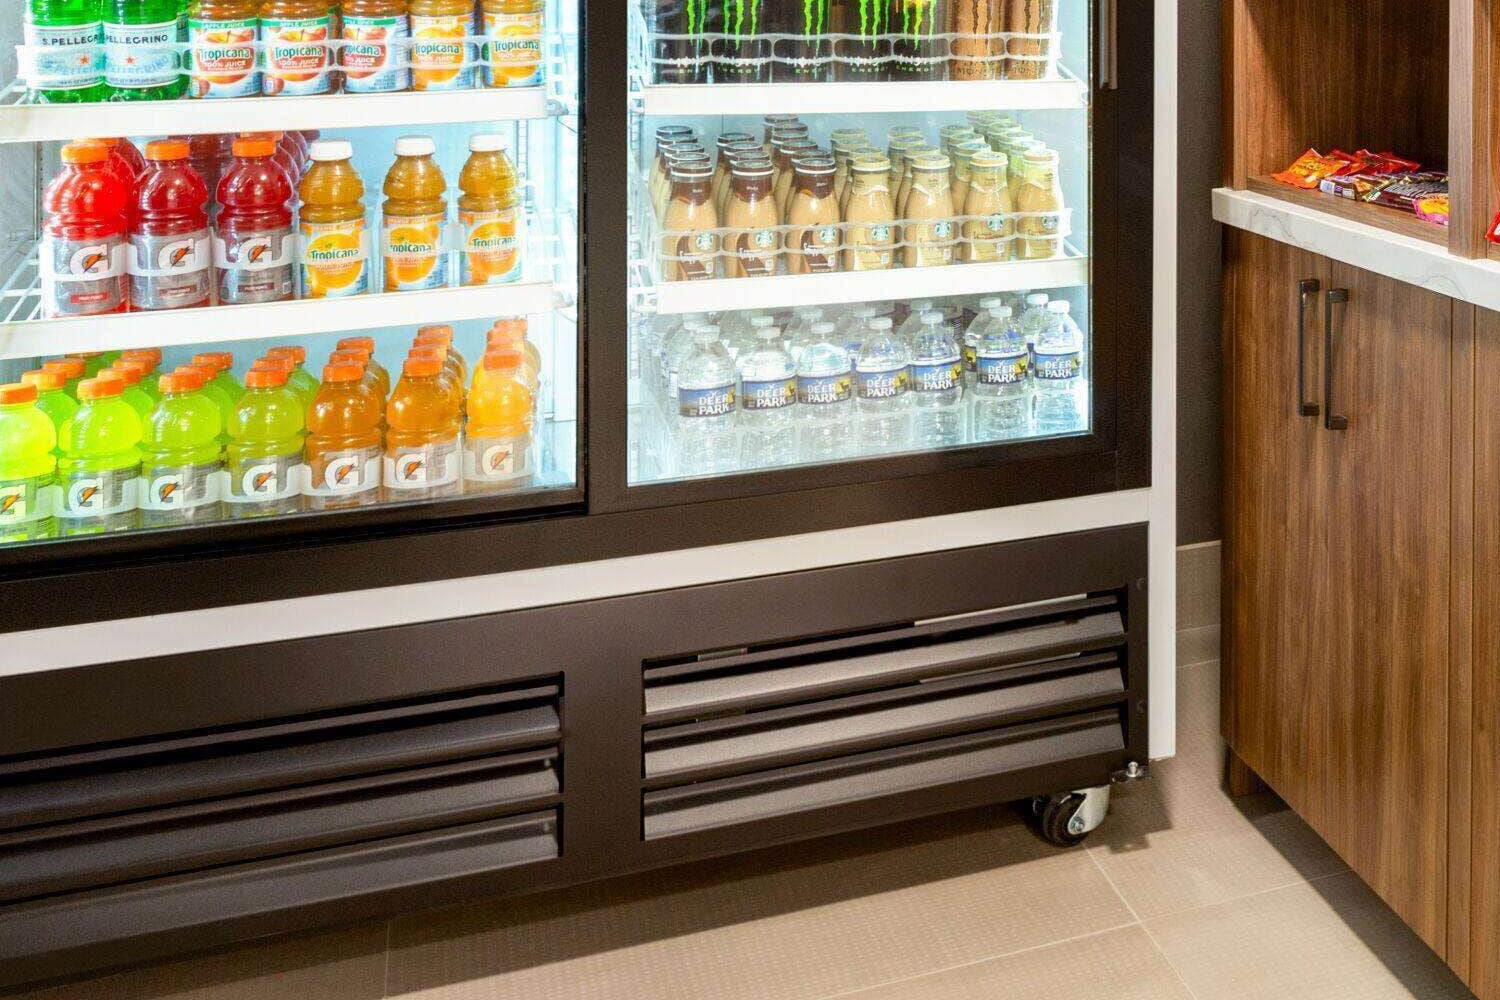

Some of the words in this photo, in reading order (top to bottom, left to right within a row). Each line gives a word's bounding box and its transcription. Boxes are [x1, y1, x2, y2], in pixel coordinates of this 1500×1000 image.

[415, 42, 459, 54] Tropicana
[495, 40, 539, 52] Tropicana
[201, 47, 250, 60] Tropicana
[275, 46, 323, 59] Tropicana
[158, 238, 195, 272] G
[238, 236, 273, 265] G
[70, 244, 109, 275] G
[987, 364, 1015, 374] DEER
[1044, 359, 1072, 370] DEER
[923, 371, 951, 381] DEER
[987, 373, 1016, 383] PARK
[1044, 368, 1073, 379] PARK
[866, 378, 895, 388] DEER
[923, 380, 953, 390] PARK
[757, 388, 786, 398] DEER
[807, 384, 836, 394] DEER
[866, 387, 896, 397] PARK
[700, 395, 728, 406] DEER
[757, 397, 786, 408] PARK
[807, 393, 837, 403] PARK
[700, 405, 729, 415] PARK
[481, 444, 513, 477] G
[325, 455, 359, 490] G
[396, 453, 427, 483] G
[243, 463, 277, 496] G
[68, 478, 103, 512] G
[150, 474, 184, 506] G
